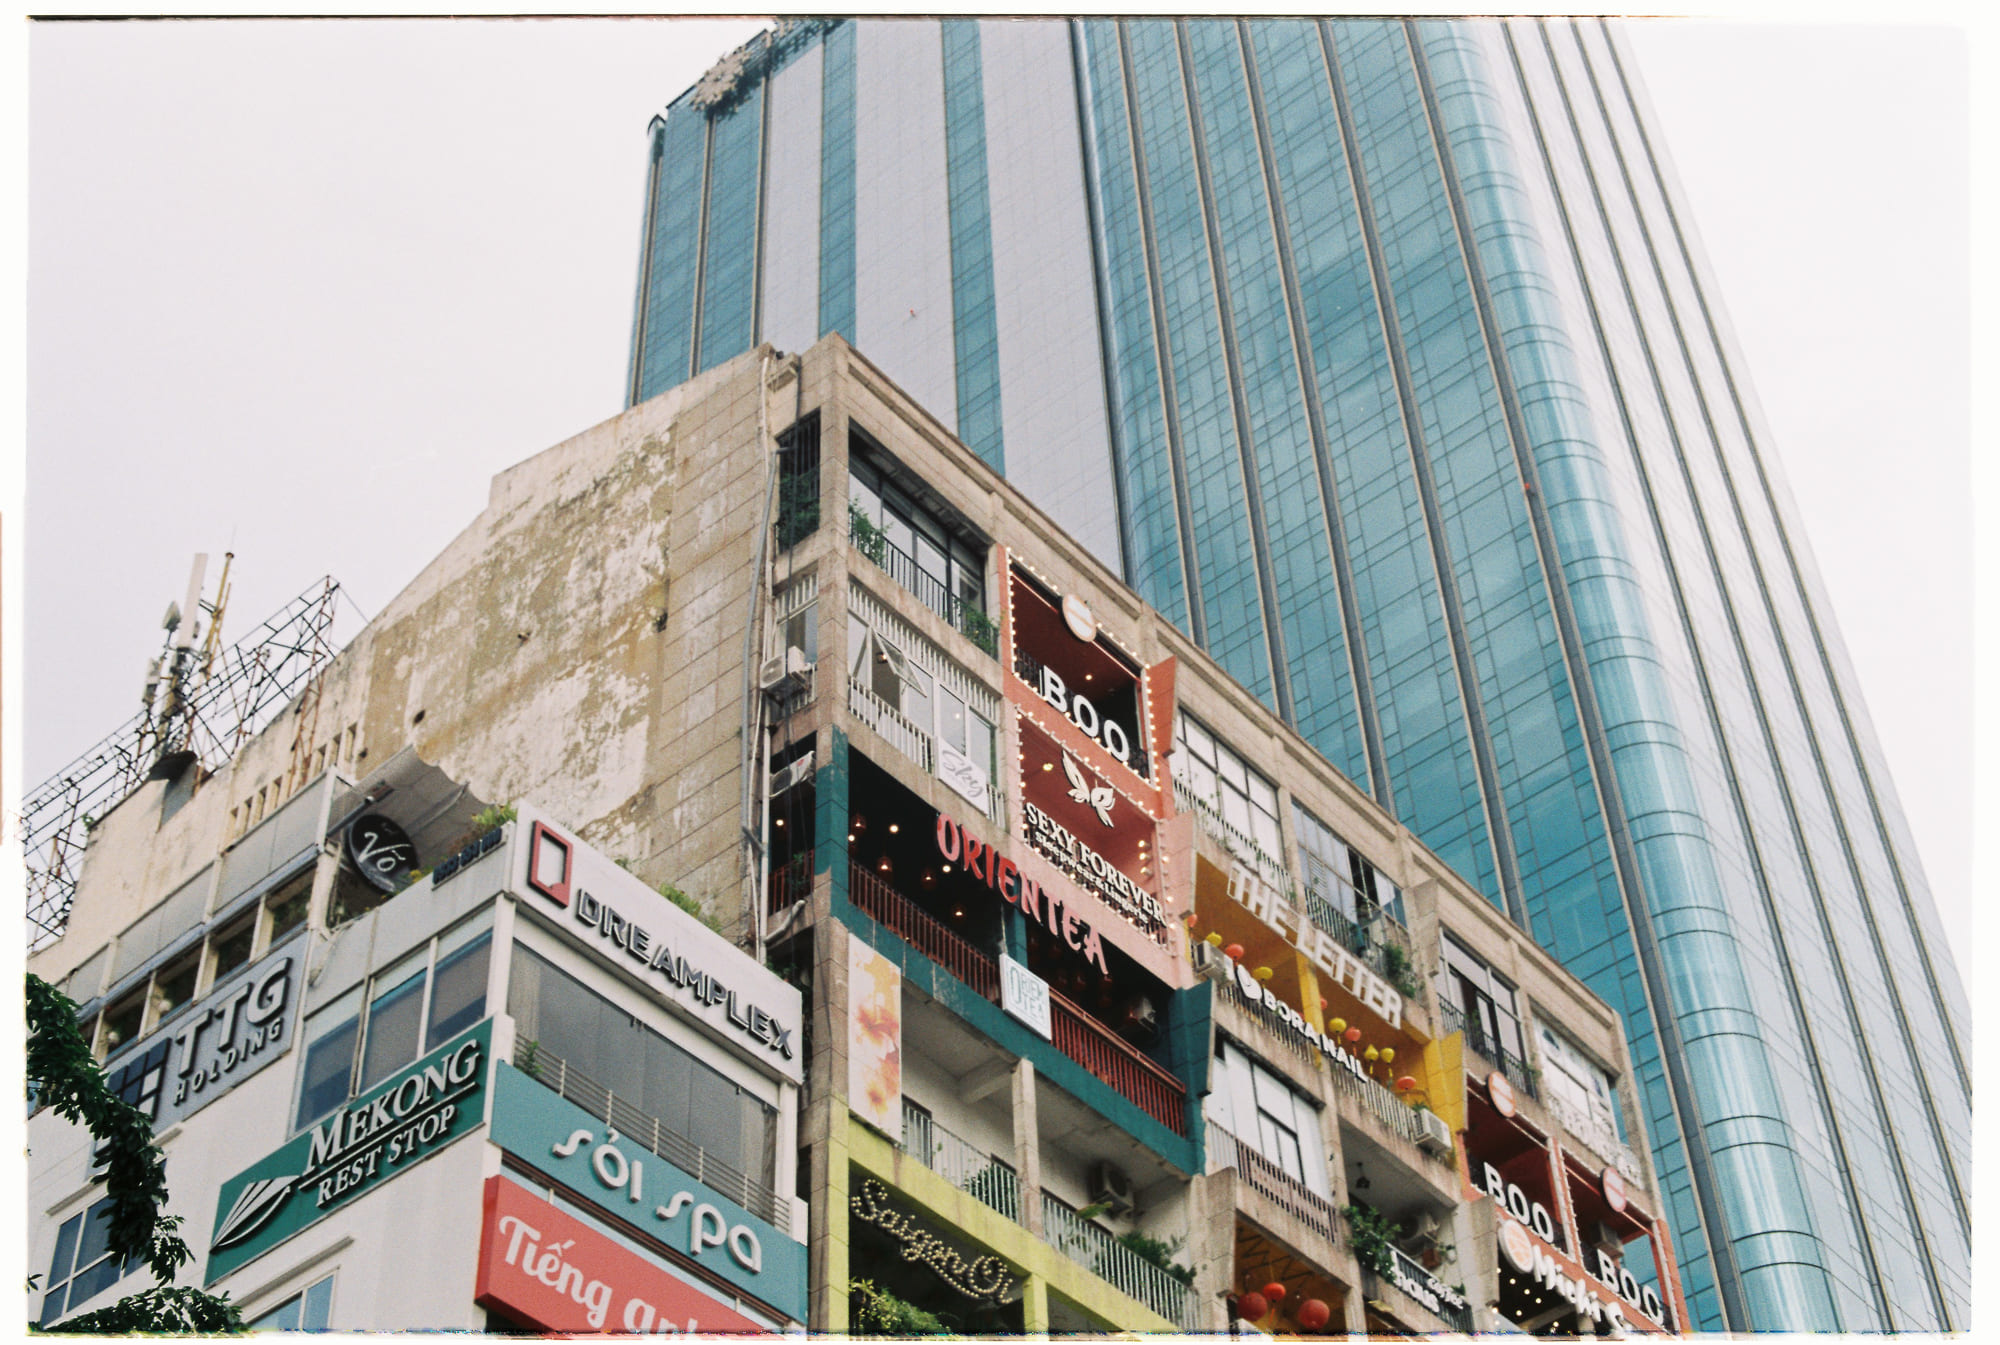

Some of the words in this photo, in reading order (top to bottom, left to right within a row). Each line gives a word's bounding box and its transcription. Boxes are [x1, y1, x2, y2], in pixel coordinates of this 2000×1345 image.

[1040, 665, 1130, 762] BOO
[942, 749, 984, 798] Sky
[937, 813, 1109, 975] ORIENTEA
[1025, 802, 1077, 857] SEXY
[1078, 841, 1168, 928] FOREVER
[577, 888, 793, 1060] DREAMPLEX
[1228, 860, 1290, 938] THE
[1295, 915, 1403, 1031] LETTER
[173, 1017, 284, 1107] HOLDING
[175, 956, 293, 1080] TTG
[1262, 987, 1320, 1047] BORA
[1320, 1033, 1369, 1084] NAIL
[303, 1039, 481, 1177] MEKONG
[316, 1145, 383, 1208] REST
[387, 1104, 457, 1164] STOP
[655, 1190, 763, 1275] spa
[1484, 1161, 1555, 1244] BOO
[499, 1216, 613, 1329] Tiếng
[1597, 1248, 1664, 1326] BOO
